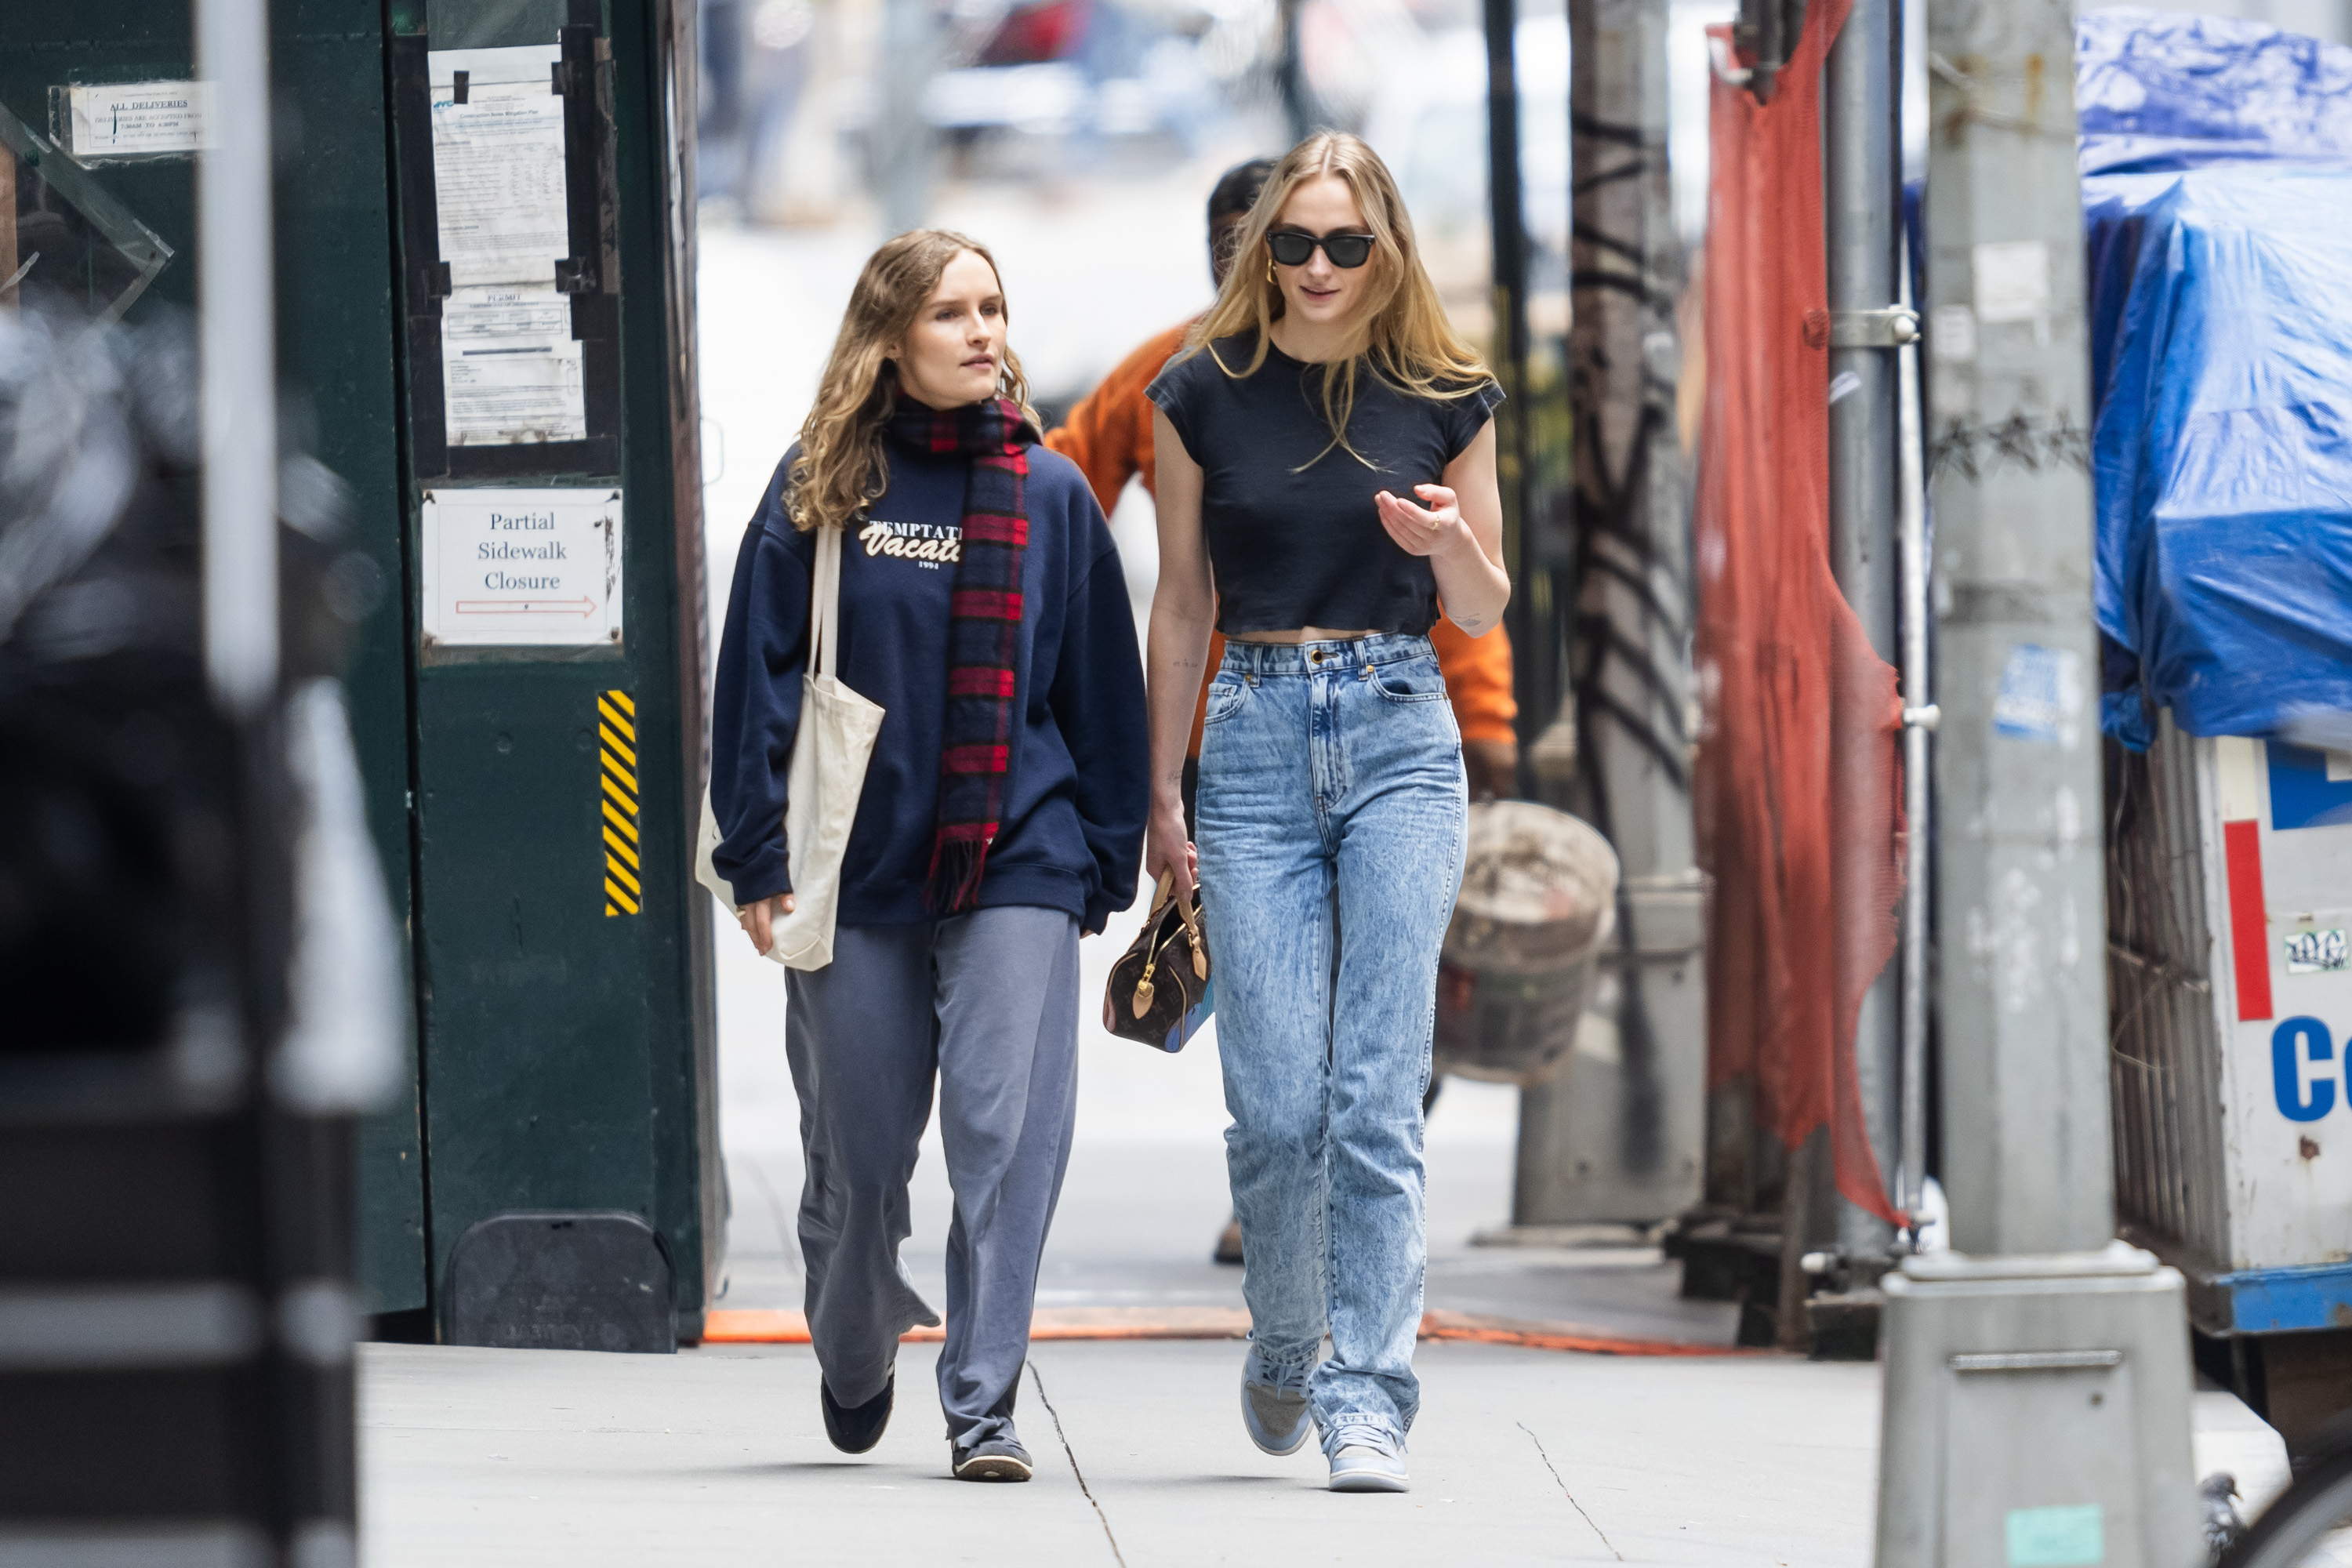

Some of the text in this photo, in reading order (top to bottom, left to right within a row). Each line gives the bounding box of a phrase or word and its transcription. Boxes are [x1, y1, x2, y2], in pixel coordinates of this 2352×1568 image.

[132, 100, 188, 110] DELIVERIES
[490, 512, 554, 530] Partial
[477, 541, 567, 560] Sidewalk
[485, 572, 560, 590] Closure
[2270, 1014, 2352, 1121] C
